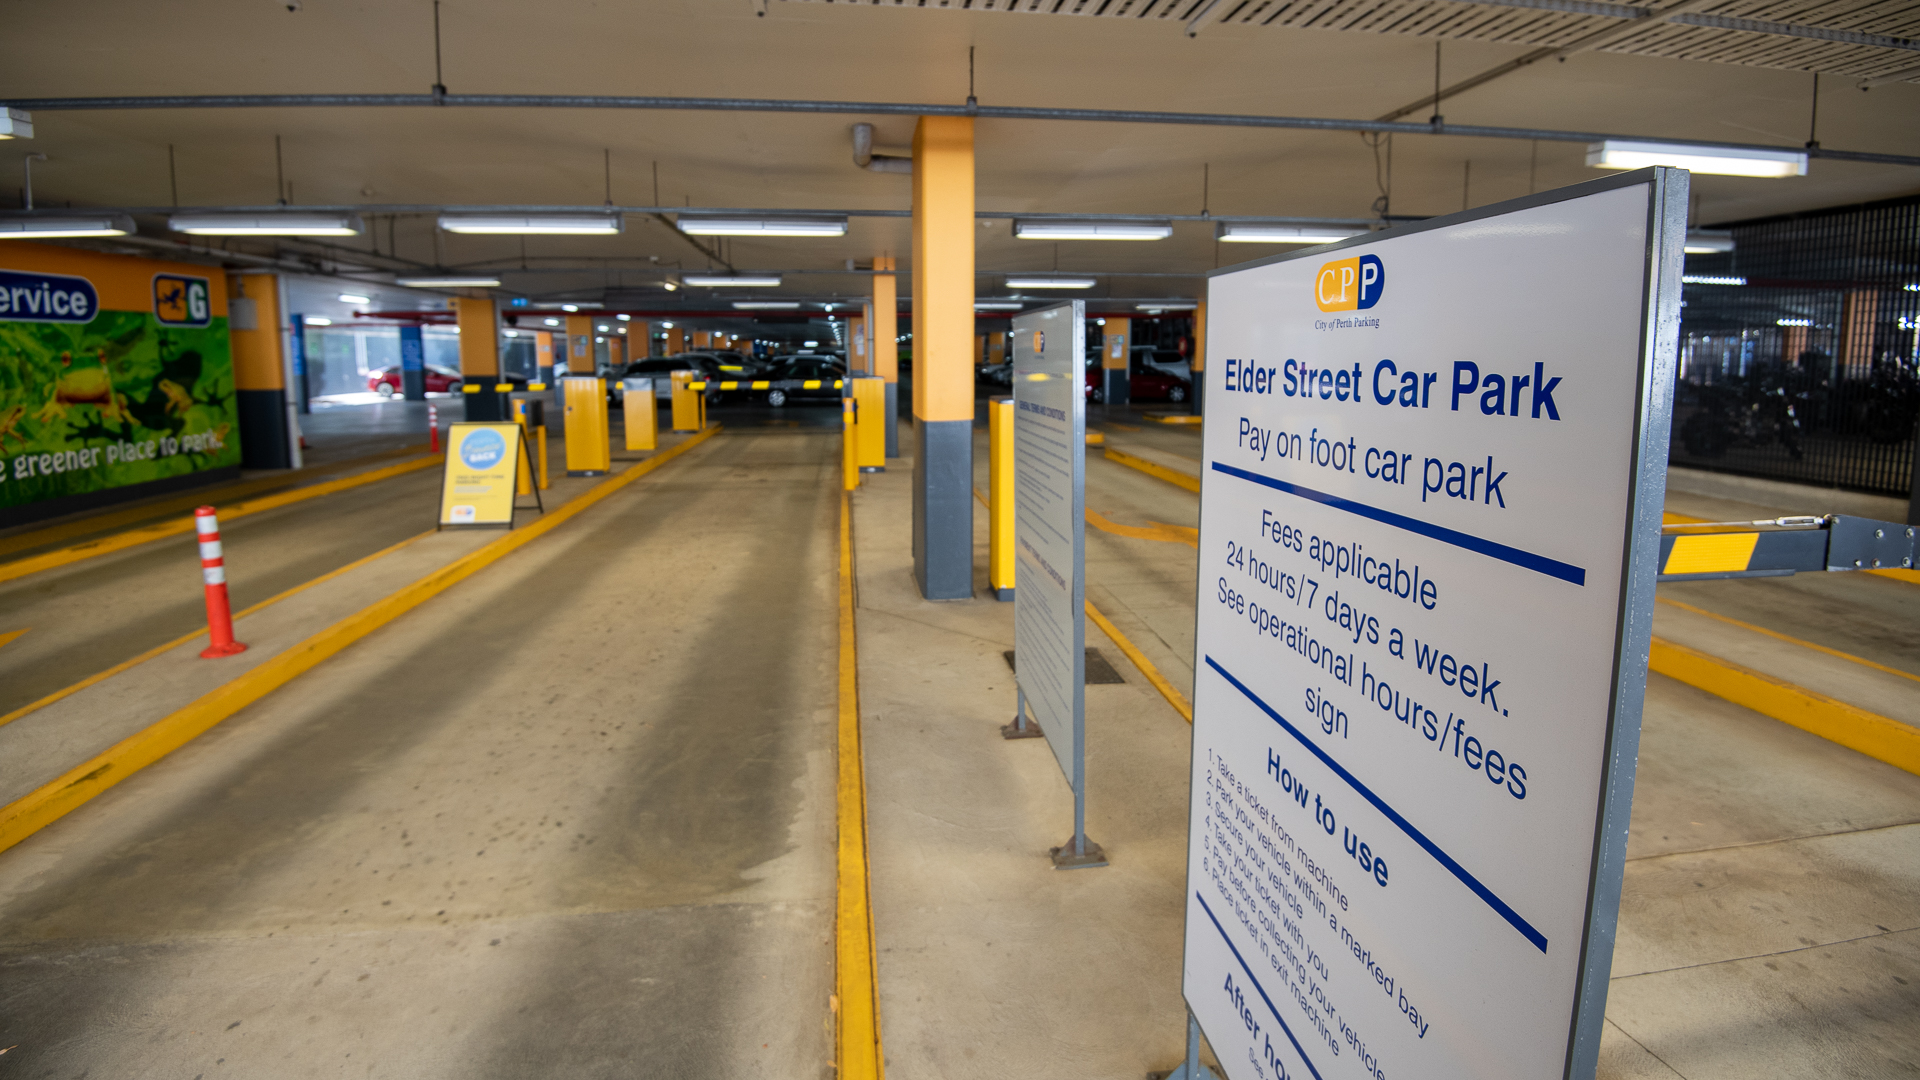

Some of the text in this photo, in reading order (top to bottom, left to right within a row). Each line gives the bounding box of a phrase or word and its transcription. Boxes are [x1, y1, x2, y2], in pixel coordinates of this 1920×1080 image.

[188, 283, 207, 320] G
[1315, 315, 1380, 331] City of Perth Parking
[1225, 358, 1563, 421] Elder Street Car Park
[14, 446, 101, 480] greener
[106, 438, 155, 464] place
[160, 436, 178, 455] to
[1239, 417, 1508, 509] Pay on foot car park
[1262, 509, 1438, 610] Fees applicable
[1226, 541, 1509, 717] 24 hours/7 days a week.
[1218, 577, 1527, 800] See operational hours/fees
[1305, 687, 1348, 739] sign
[1206, 791, 1303, 920] 3. Secure your vehicle
[1208, 748, 1348, 911] 1. Take a ticket from machine
[1267, 747, 1389, 887] How to use
[1203, 857, 1339, 1056] 6. Place ticket in exit machine
[1204, 835, 1211, 853] 5.
[1213, 846, 1228, 876] Pay
[1229, 868, 1257, 913] before
[1258, 909, 1306, 984] collecting
[1309, 976, 1336, 1019] your
[1205, 815, 1329, 982] 4. Take your ticket with you
[1206, 769, 1429, 1039] 2. Park your vehicle within a marked bay
[1223, 972, 1291, 1080] After ho
[1248, 1047, 1264, 1079] See
